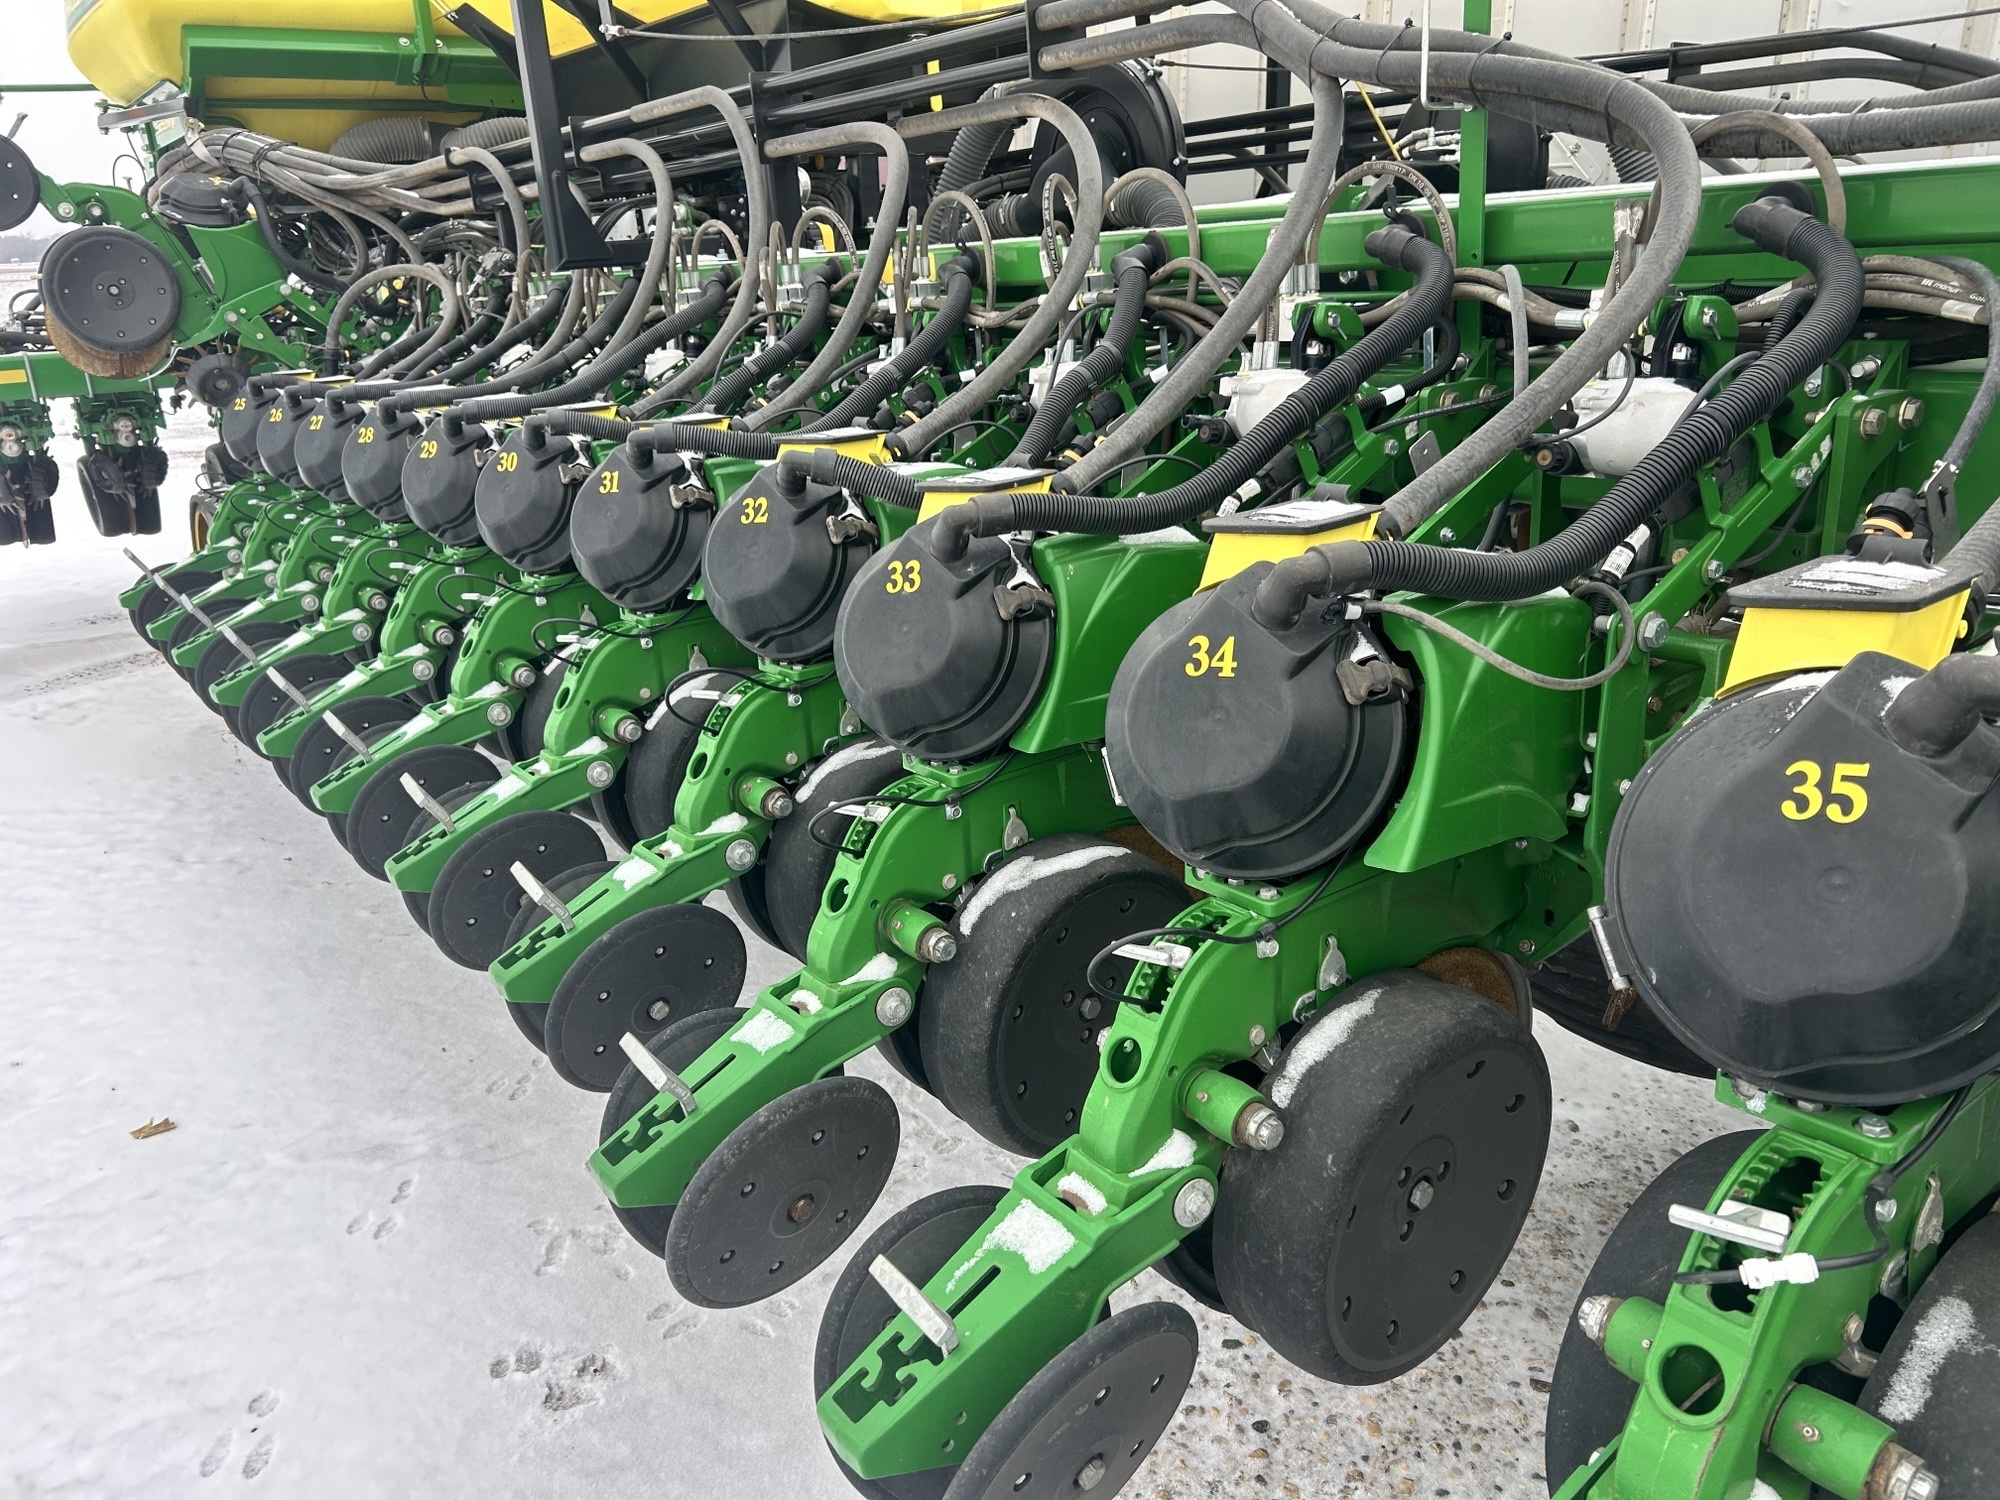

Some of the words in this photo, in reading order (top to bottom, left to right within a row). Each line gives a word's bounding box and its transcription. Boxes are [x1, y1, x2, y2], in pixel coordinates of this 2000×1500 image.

[234, 398, 246, 411] 25
[269, 408, 283, 422] 26
[309, 415, 323, 430] 27
[358, 427, 374, 443] 28
[419, 440, 438, 459] 29
[497, 452, 518, 472] 30
[600, 470, 620, 493] 31
[740, 495, 769, 525] 32
[885, 558, 922, 594] 33
[1184, 633, 1238, 678] 34
[1780, 759, 1871, 824] 35
